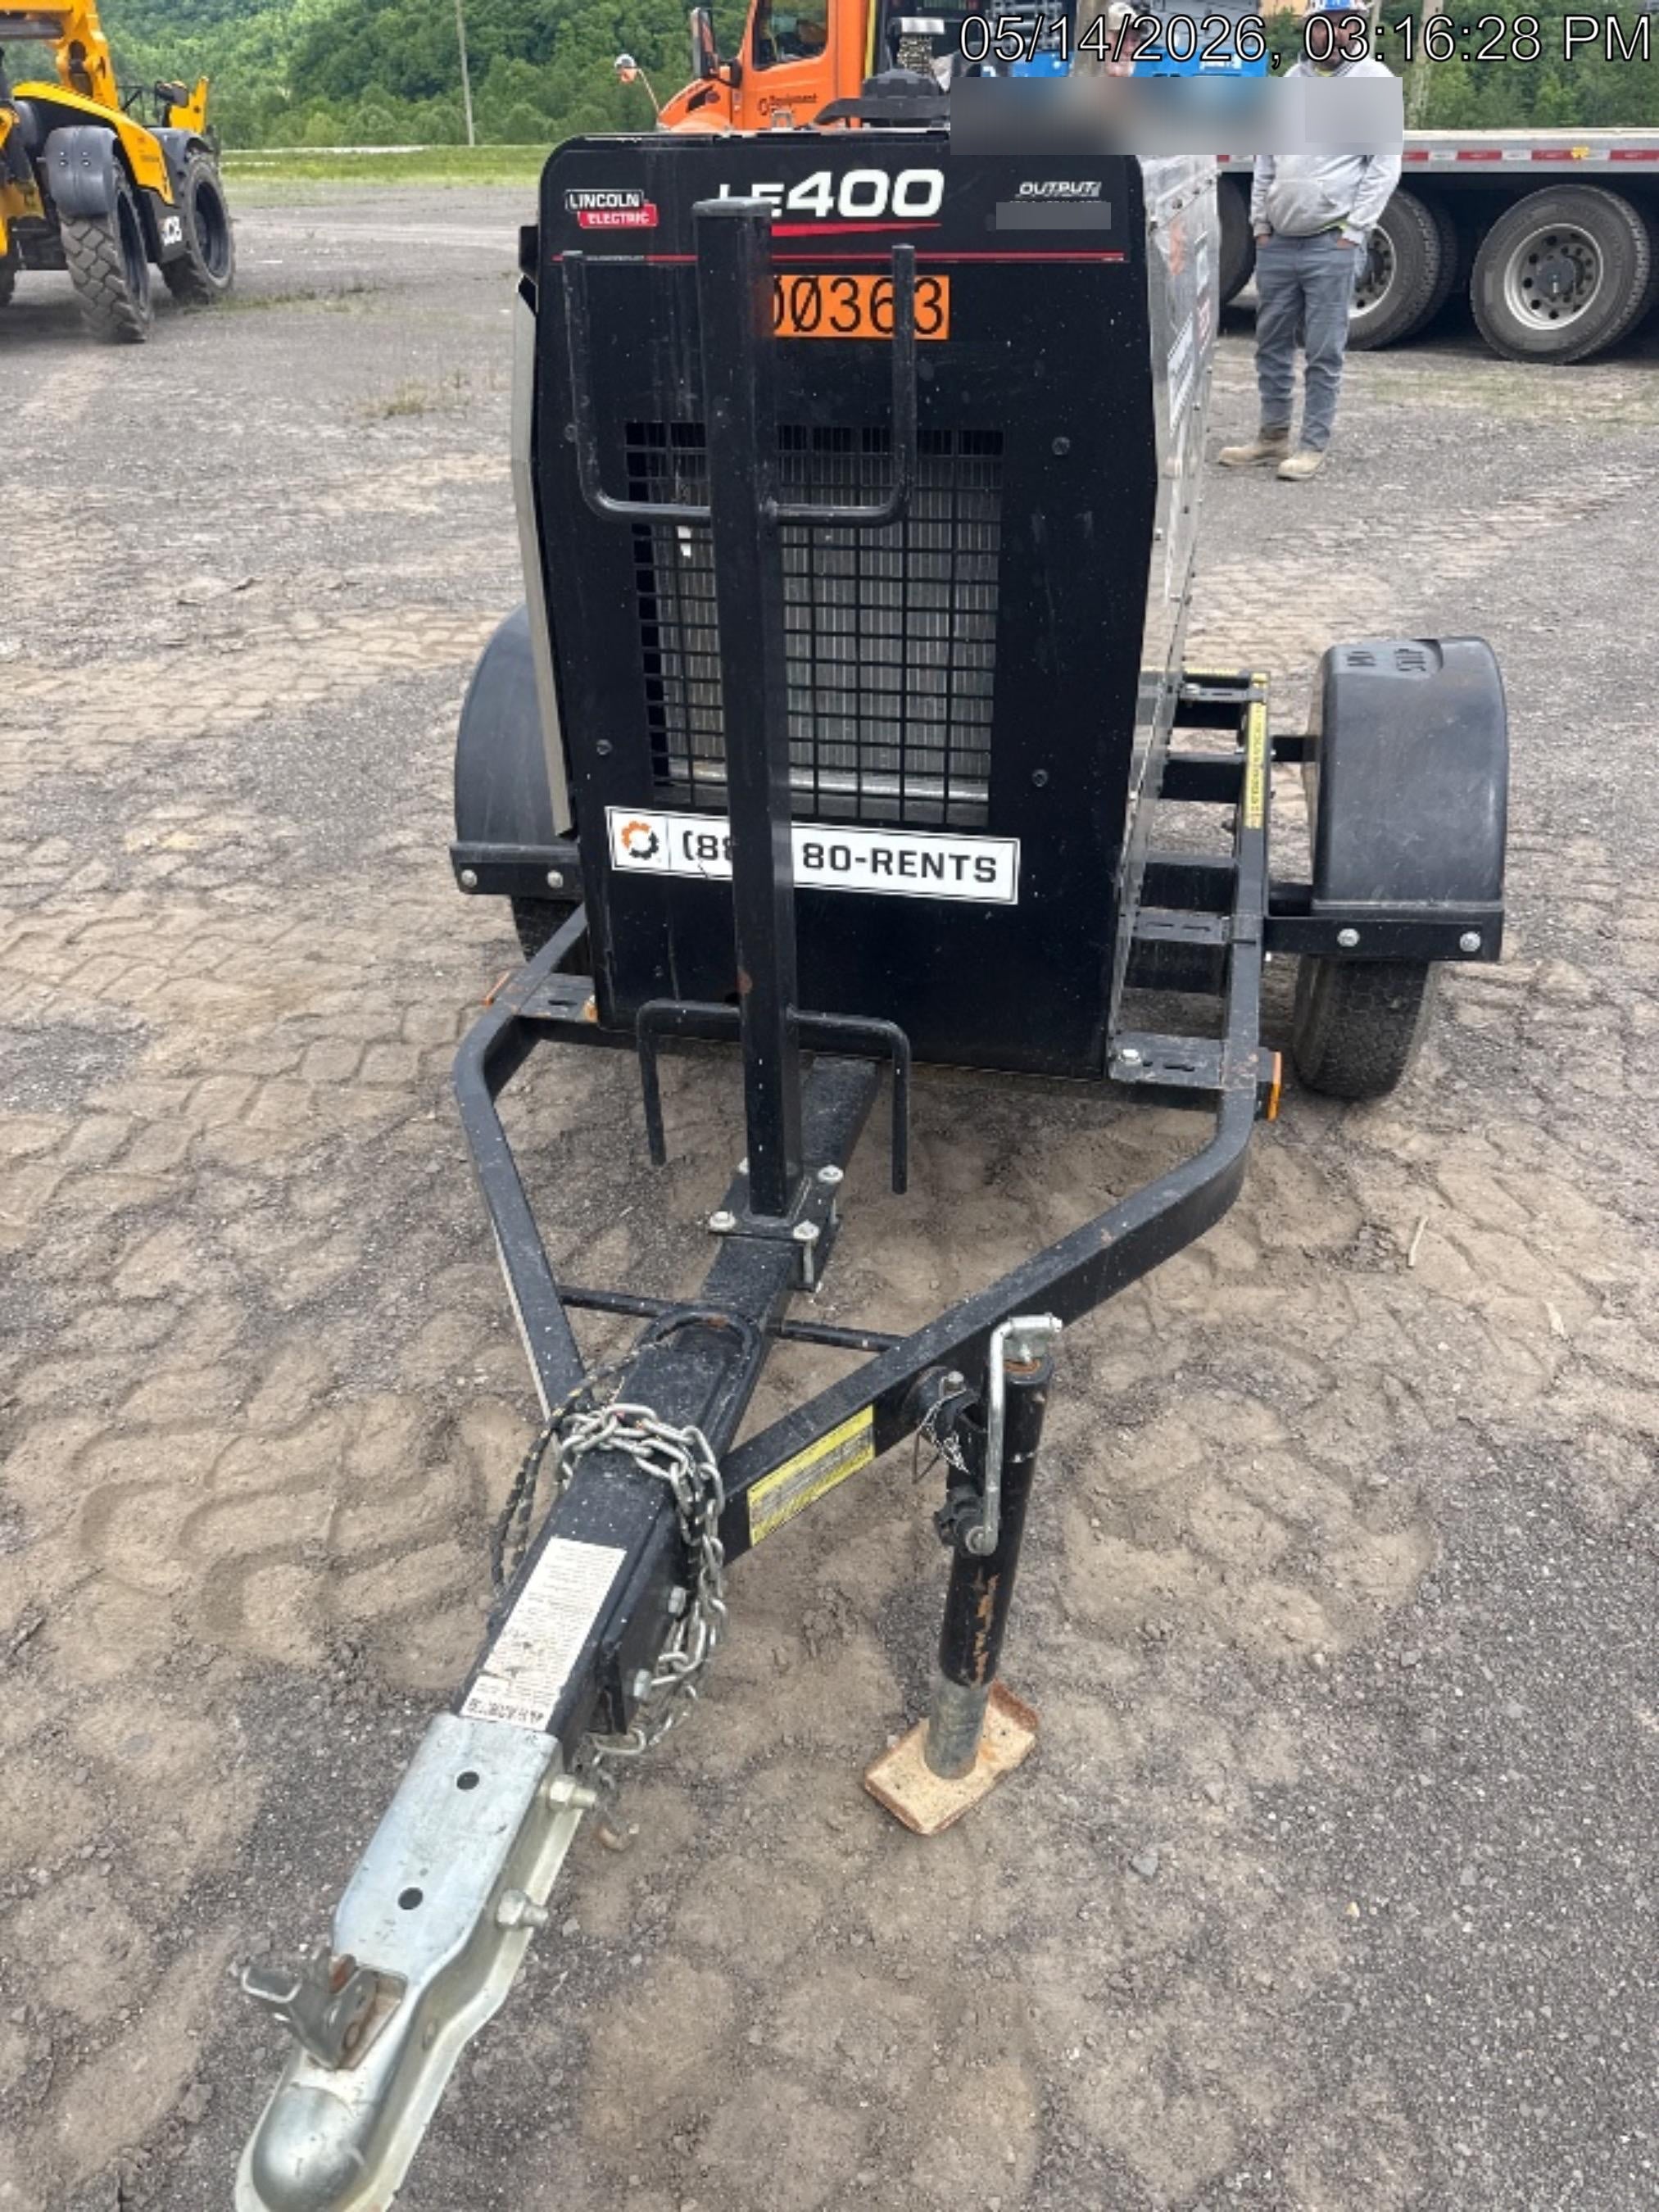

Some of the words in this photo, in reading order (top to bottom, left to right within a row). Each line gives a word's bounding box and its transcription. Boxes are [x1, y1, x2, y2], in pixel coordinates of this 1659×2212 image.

[1019, 181, 1093, 196] OUTPUT
[569, 193, 641, 209] LINCOLN
[586, 211, 650, 224] ELECTRIC
